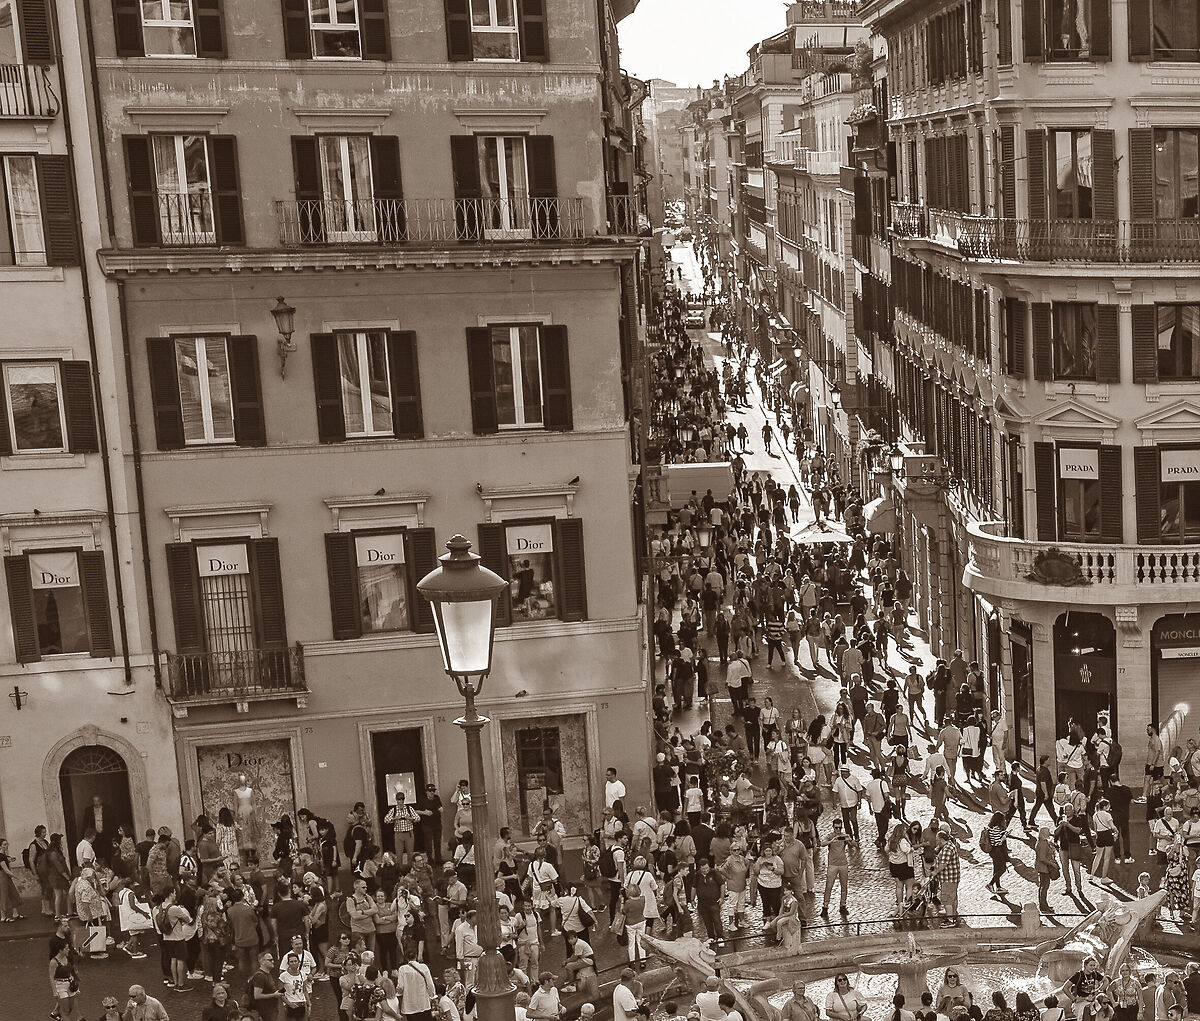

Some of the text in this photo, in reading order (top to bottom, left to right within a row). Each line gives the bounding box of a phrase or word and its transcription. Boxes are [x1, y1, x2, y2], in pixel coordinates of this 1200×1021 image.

[1065, 464, 1094, 472] PRADA
[517, 538, 544, 550] Dior
[367, 549, 396, 562] Dior
[209, 559, 239, 572] Dior
[41, 572, 71, 585] Dior
[226, 752, 265, 769] Dior
